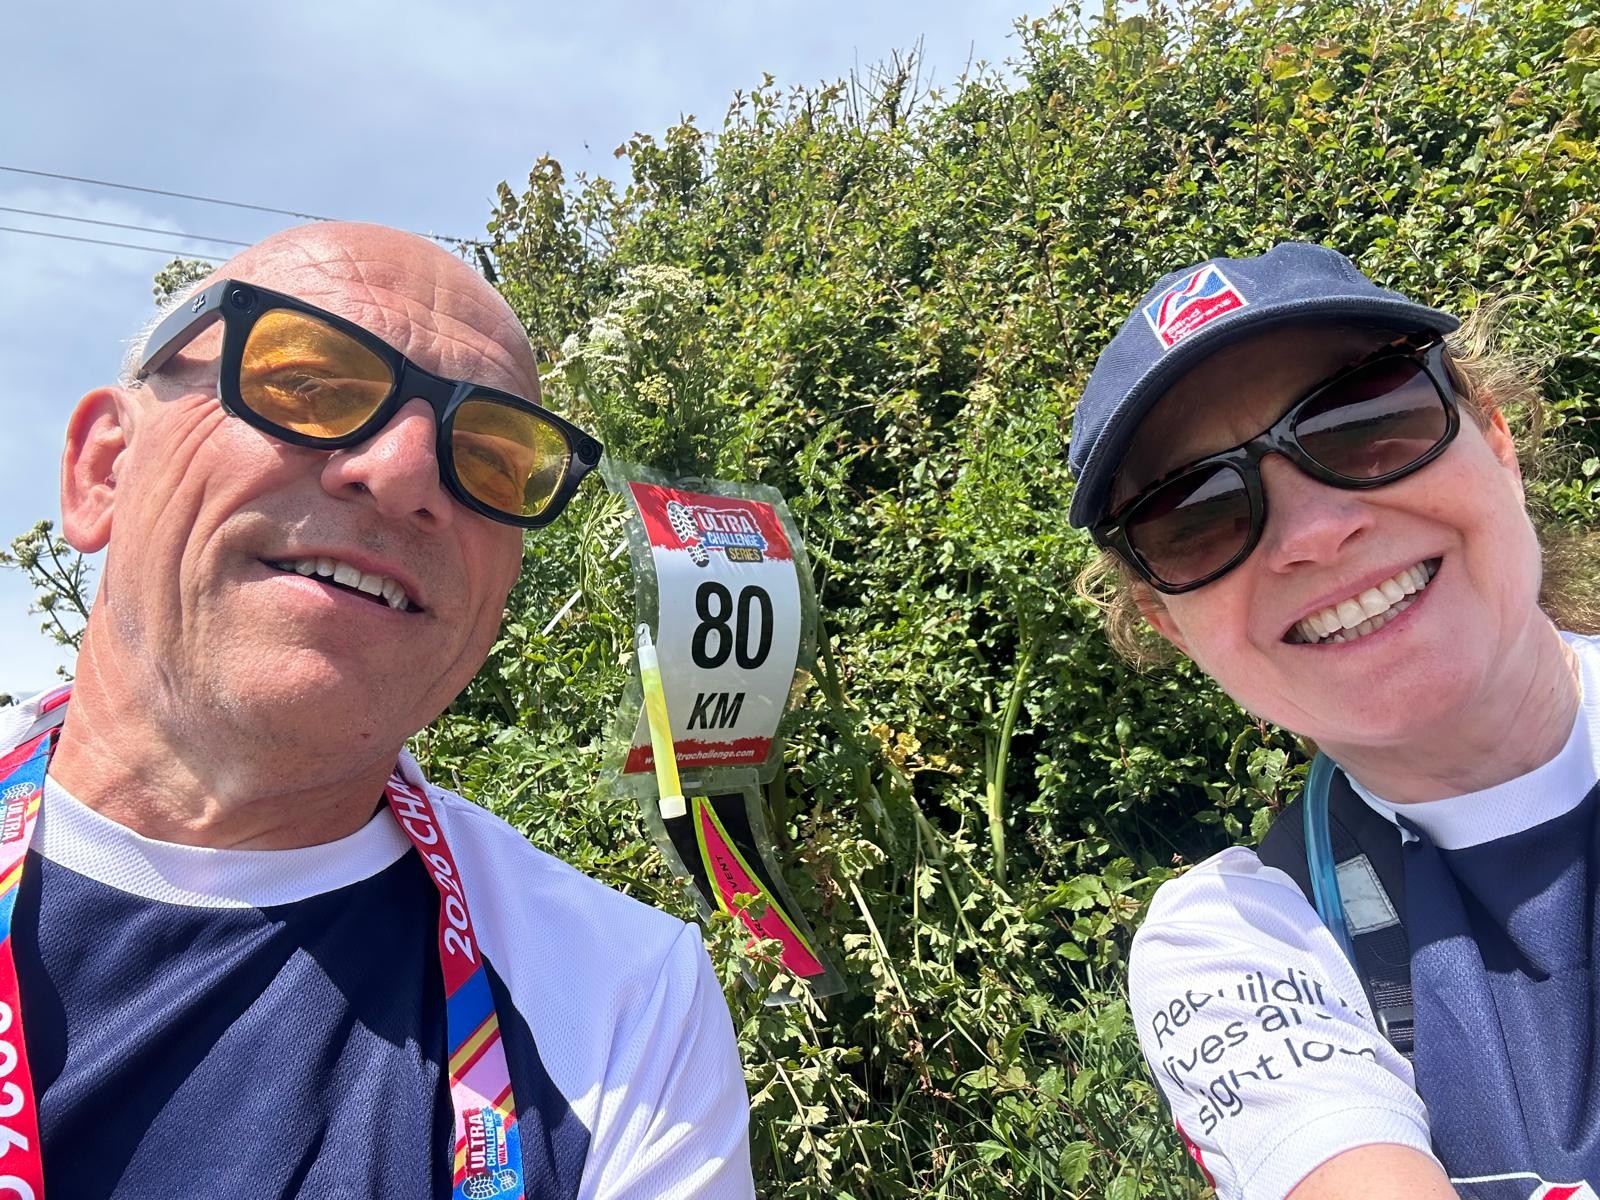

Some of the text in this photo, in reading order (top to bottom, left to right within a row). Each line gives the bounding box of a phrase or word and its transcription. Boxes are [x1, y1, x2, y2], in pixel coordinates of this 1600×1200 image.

[697, 512, 755, 534] ULTRA
[707, 531, 761, 547] CHALLENGE
[728, 547, 760, 560] SERIES
[691, 581, 773, 669] 80
[687, 692, 745, 730] KM
[2, 802, 25, 841] ULTRA
[716, 854, 744, 894] VENT
[422, 850, 475, 964] 2026
[469, 1113, 486, 1169] ULTRA
[484, 1111, 497, 1167] CHALLENGE
[498, 1143, 507, 1165] WALK
